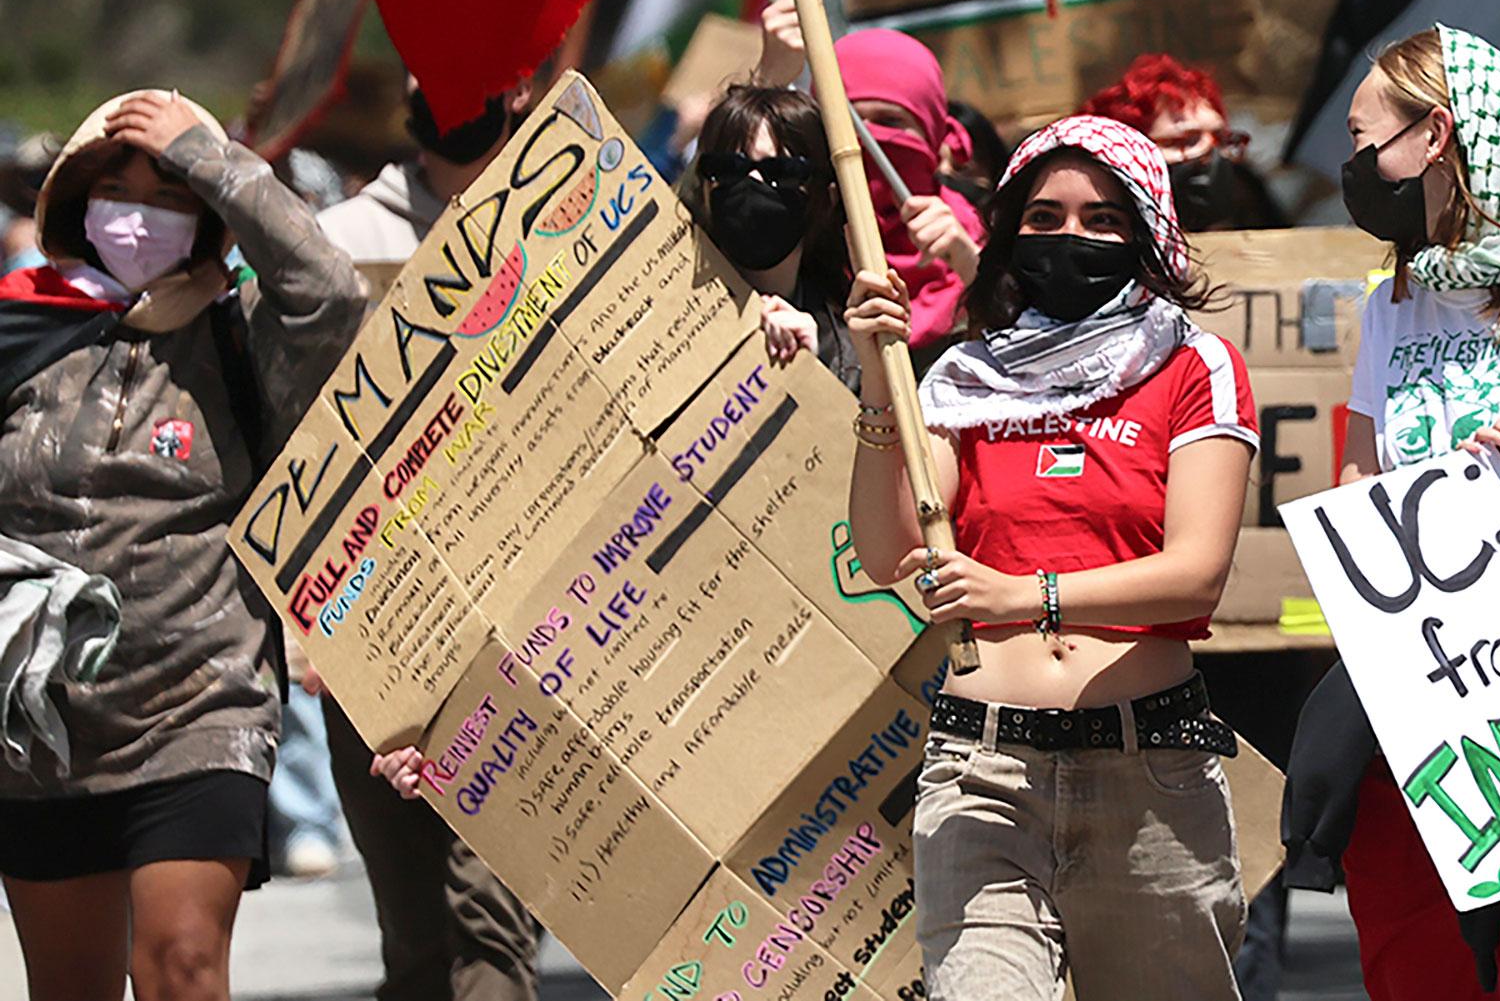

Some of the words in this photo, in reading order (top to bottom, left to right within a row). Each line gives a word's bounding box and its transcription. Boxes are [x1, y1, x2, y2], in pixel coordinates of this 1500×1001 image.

[527, 405, 563, 452] assets
[658, 252, 691, 290] and
[618, 276, 639, 303] the
[636, 340, 664, 372] that
[667, 295, 702, 339] result
[288, 560, 348, 631] FULL
[342, 506, 379, 564] AND
[383, 391, 465, 500] COMPLETE
[458, 250, 567, 405] DIVESTMENT
[573, 223, 598, 267] OF
[319, 560, 375, 636] FUNDS
[380, 474, 440, 549] FROM
[444, 402, 493, 464] WAR
[415, 695, 497, 797] REINVEST
[498, 615, 570, 686] FUNDS
[566, 574, 596, 605] TO
[592, 483, 672, 574] IMPROVE
[670, 365, 768, 485] STUDENT
[560, 680, 628, 765] affordable
[628, 622, 683, 678] housing
[676, 599, 702, 623] fit
[698, 571, 722, 600] for
[725, 540, 750, 571] the
[752, 477, 798, 538] shelter
[804, 445, 823, 472] of
[456, 708, 538, 816] QUALITY
[538, 648, 574, 697] OF
[585, 580, 646, 647] LIFE
[517, 723, 559, 780] including
[578, 668, 599, 695] not
[604, 613, 650, 666] limited
[653, 593, 668, 609] to
[597, 730, 652, 796] reliable
[654, 759, 681, 792] and
[704, 901, 748, 945] TO
[745, 817, 891, 988] CENSORSHIP
[842, 899, 864, 924] not
